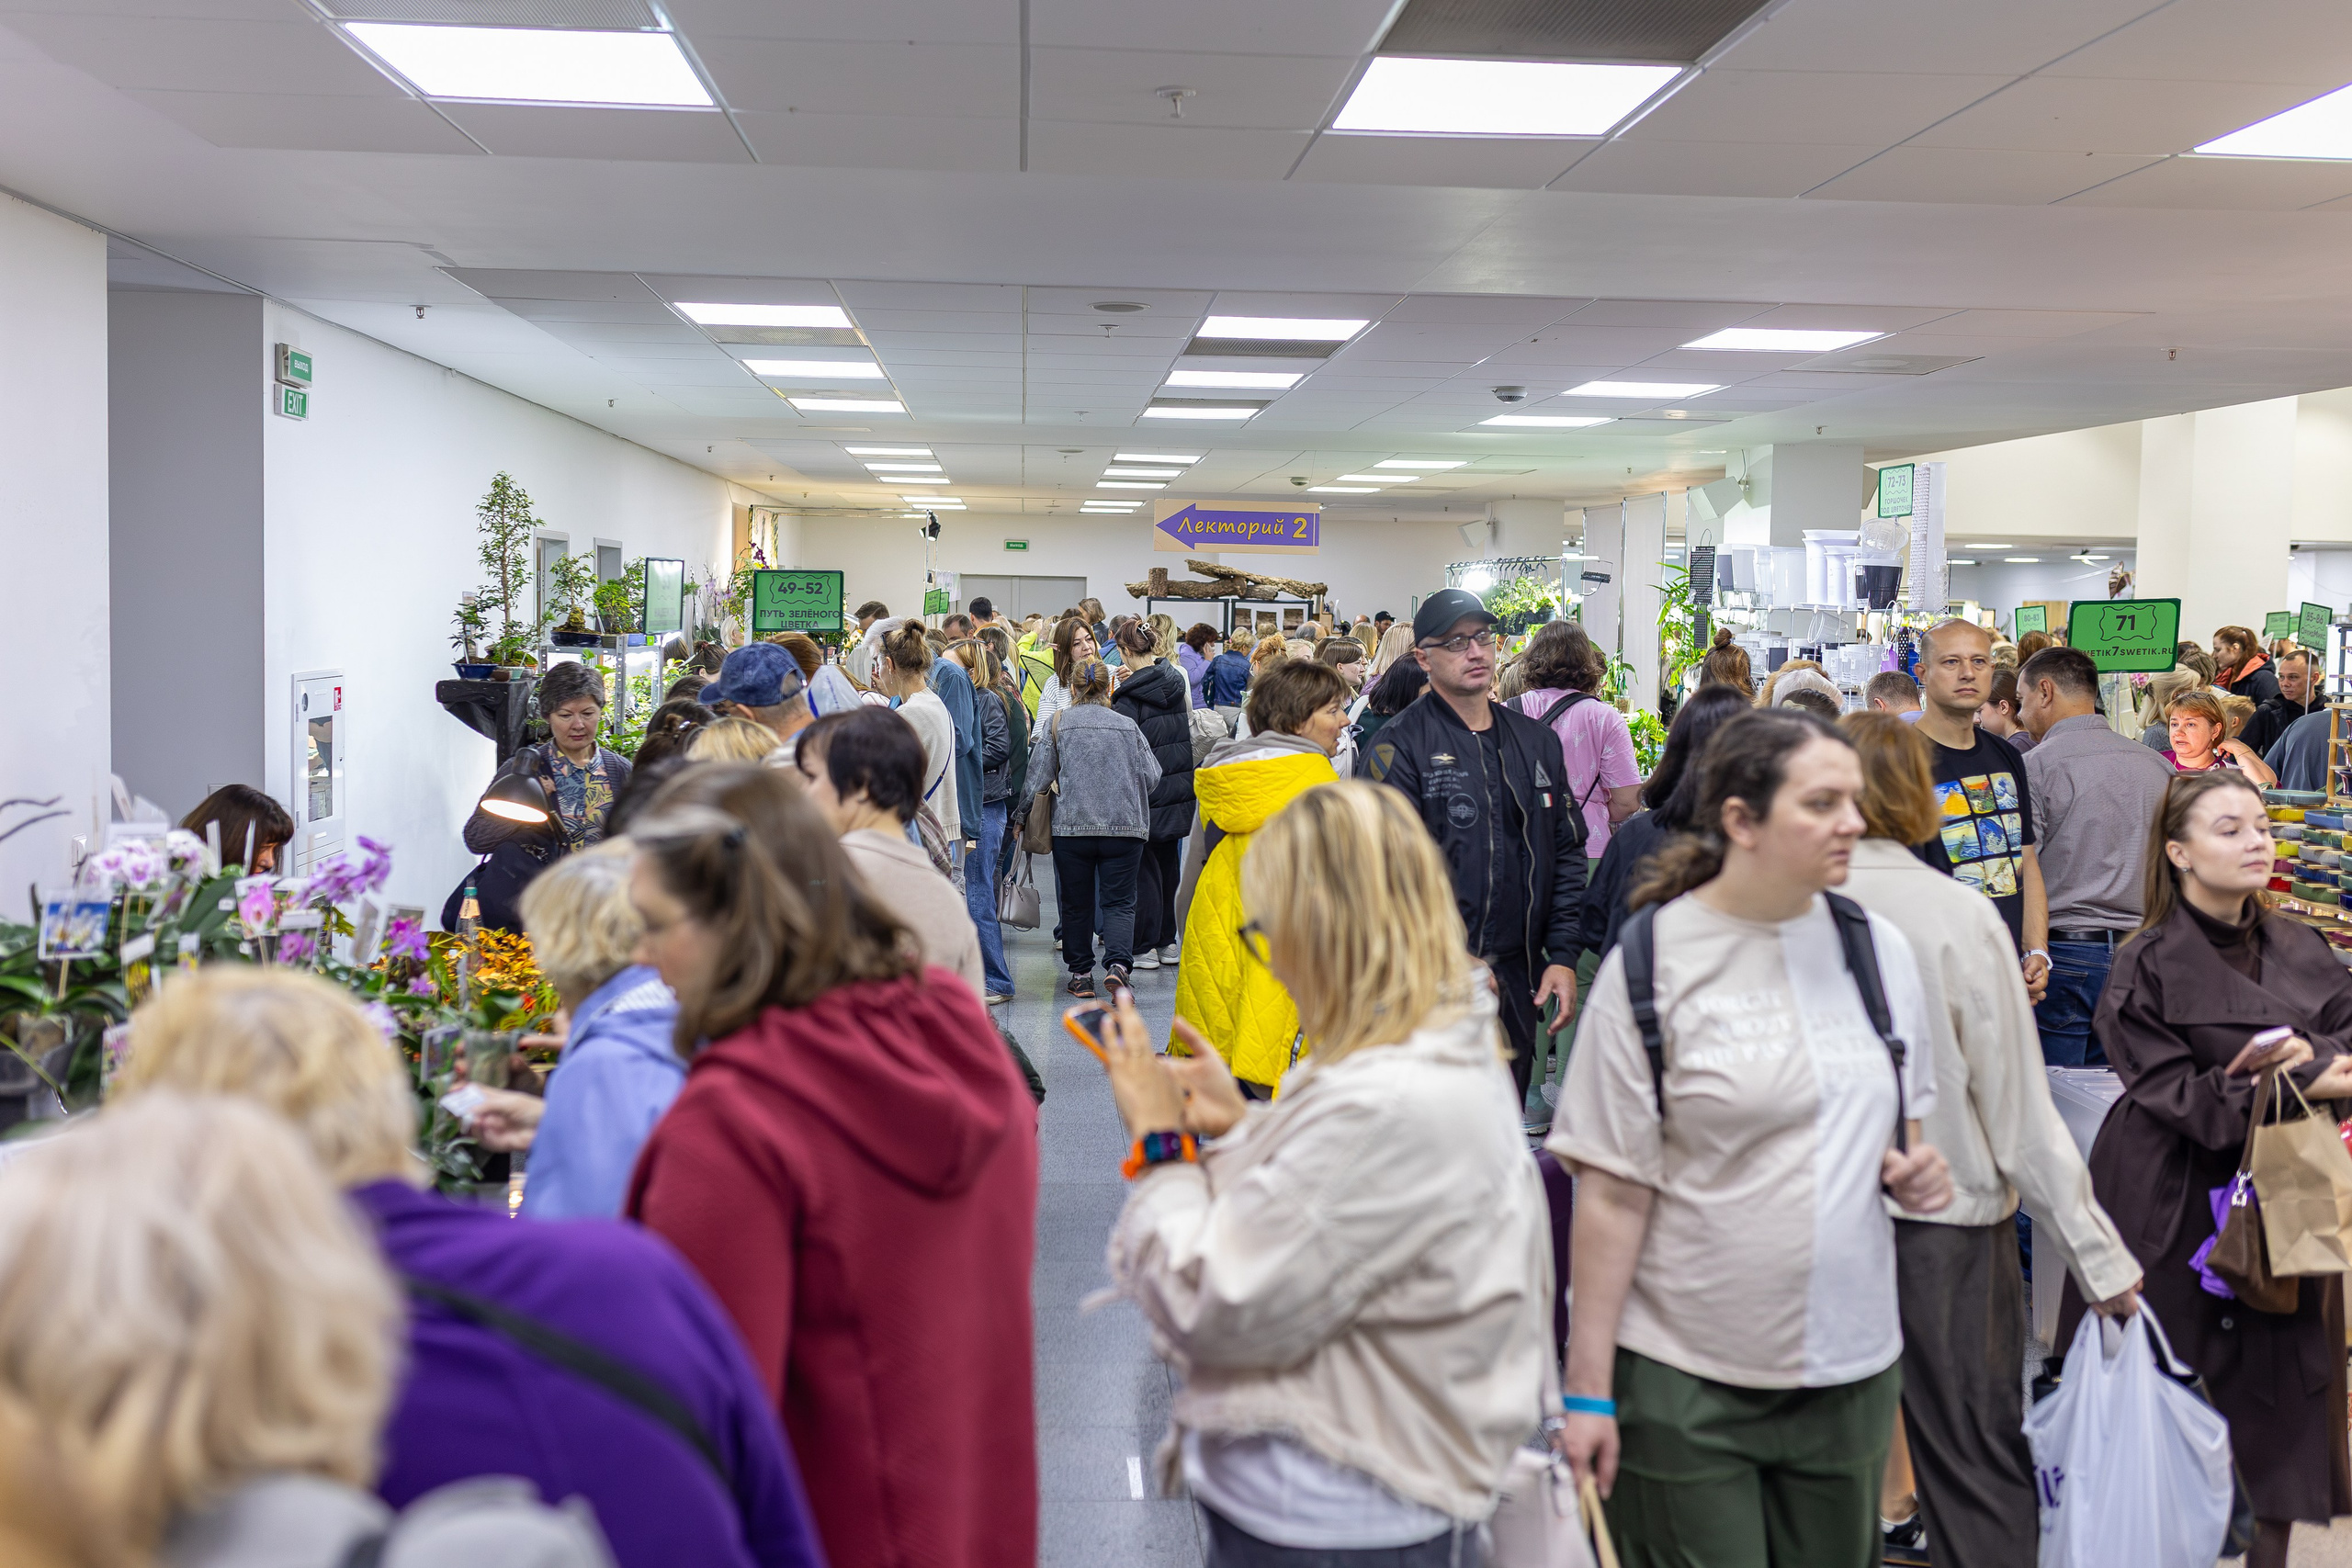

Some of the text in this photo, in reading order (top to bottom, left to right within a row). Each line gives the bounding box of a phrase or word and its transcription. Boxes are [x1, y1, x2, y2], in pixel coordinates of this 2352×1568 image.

[288, 392, 303, 414] EXIT
[1888, 475, 1906, 488] 72-73
[1884, 497, 1908, 505] ГОРШОЧЕК
[1177, 516, 1308, 540] Лекторий 2
[777, 581, 823, 594] 49-52
[760, 608, 841, 618] ПУТЬ ЗЕЛЁНОГО
[2306, 612, 2324, 625] 85-86
[780, 620, 820, 628] ЦВЕТКА
[2116, 615, 2136, 631] 71
